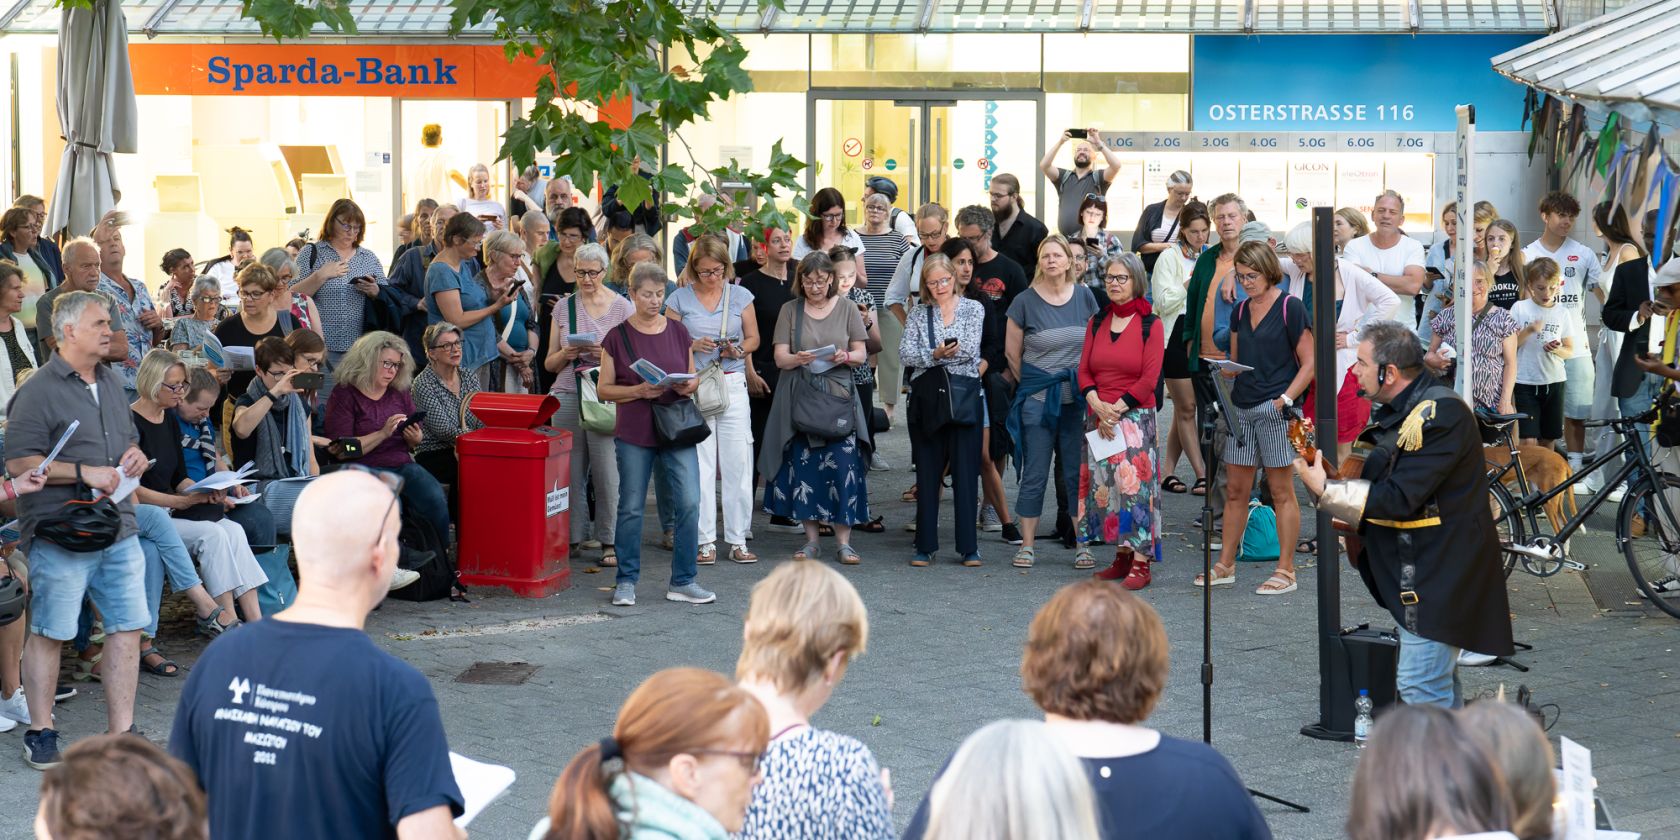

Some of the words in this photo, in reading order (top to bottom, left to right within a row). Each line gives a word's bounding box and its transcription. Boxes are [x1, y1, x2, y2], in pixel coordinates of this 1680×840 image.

[207, 56, 457, 91] Sparda-Bank
[1209, 105, 1366, 121] OSTERSTRASSE
[1376, 105, 1414, 121] 116
[1106, 137, 1133, 147] 1.OG
[1154, 137, 1180, 147] 2.OG
[1203, 137, 1229, 147] 3.OG
[1250, 137, 1277, 147] 4.OG
[1299, 137, 1326, 147] 5.OG
[1347, 137, 1375, 147] 6.OG
[1396, 137, 1424, 147] 7.OG
[1294, 162, 1329, 172] GICON
